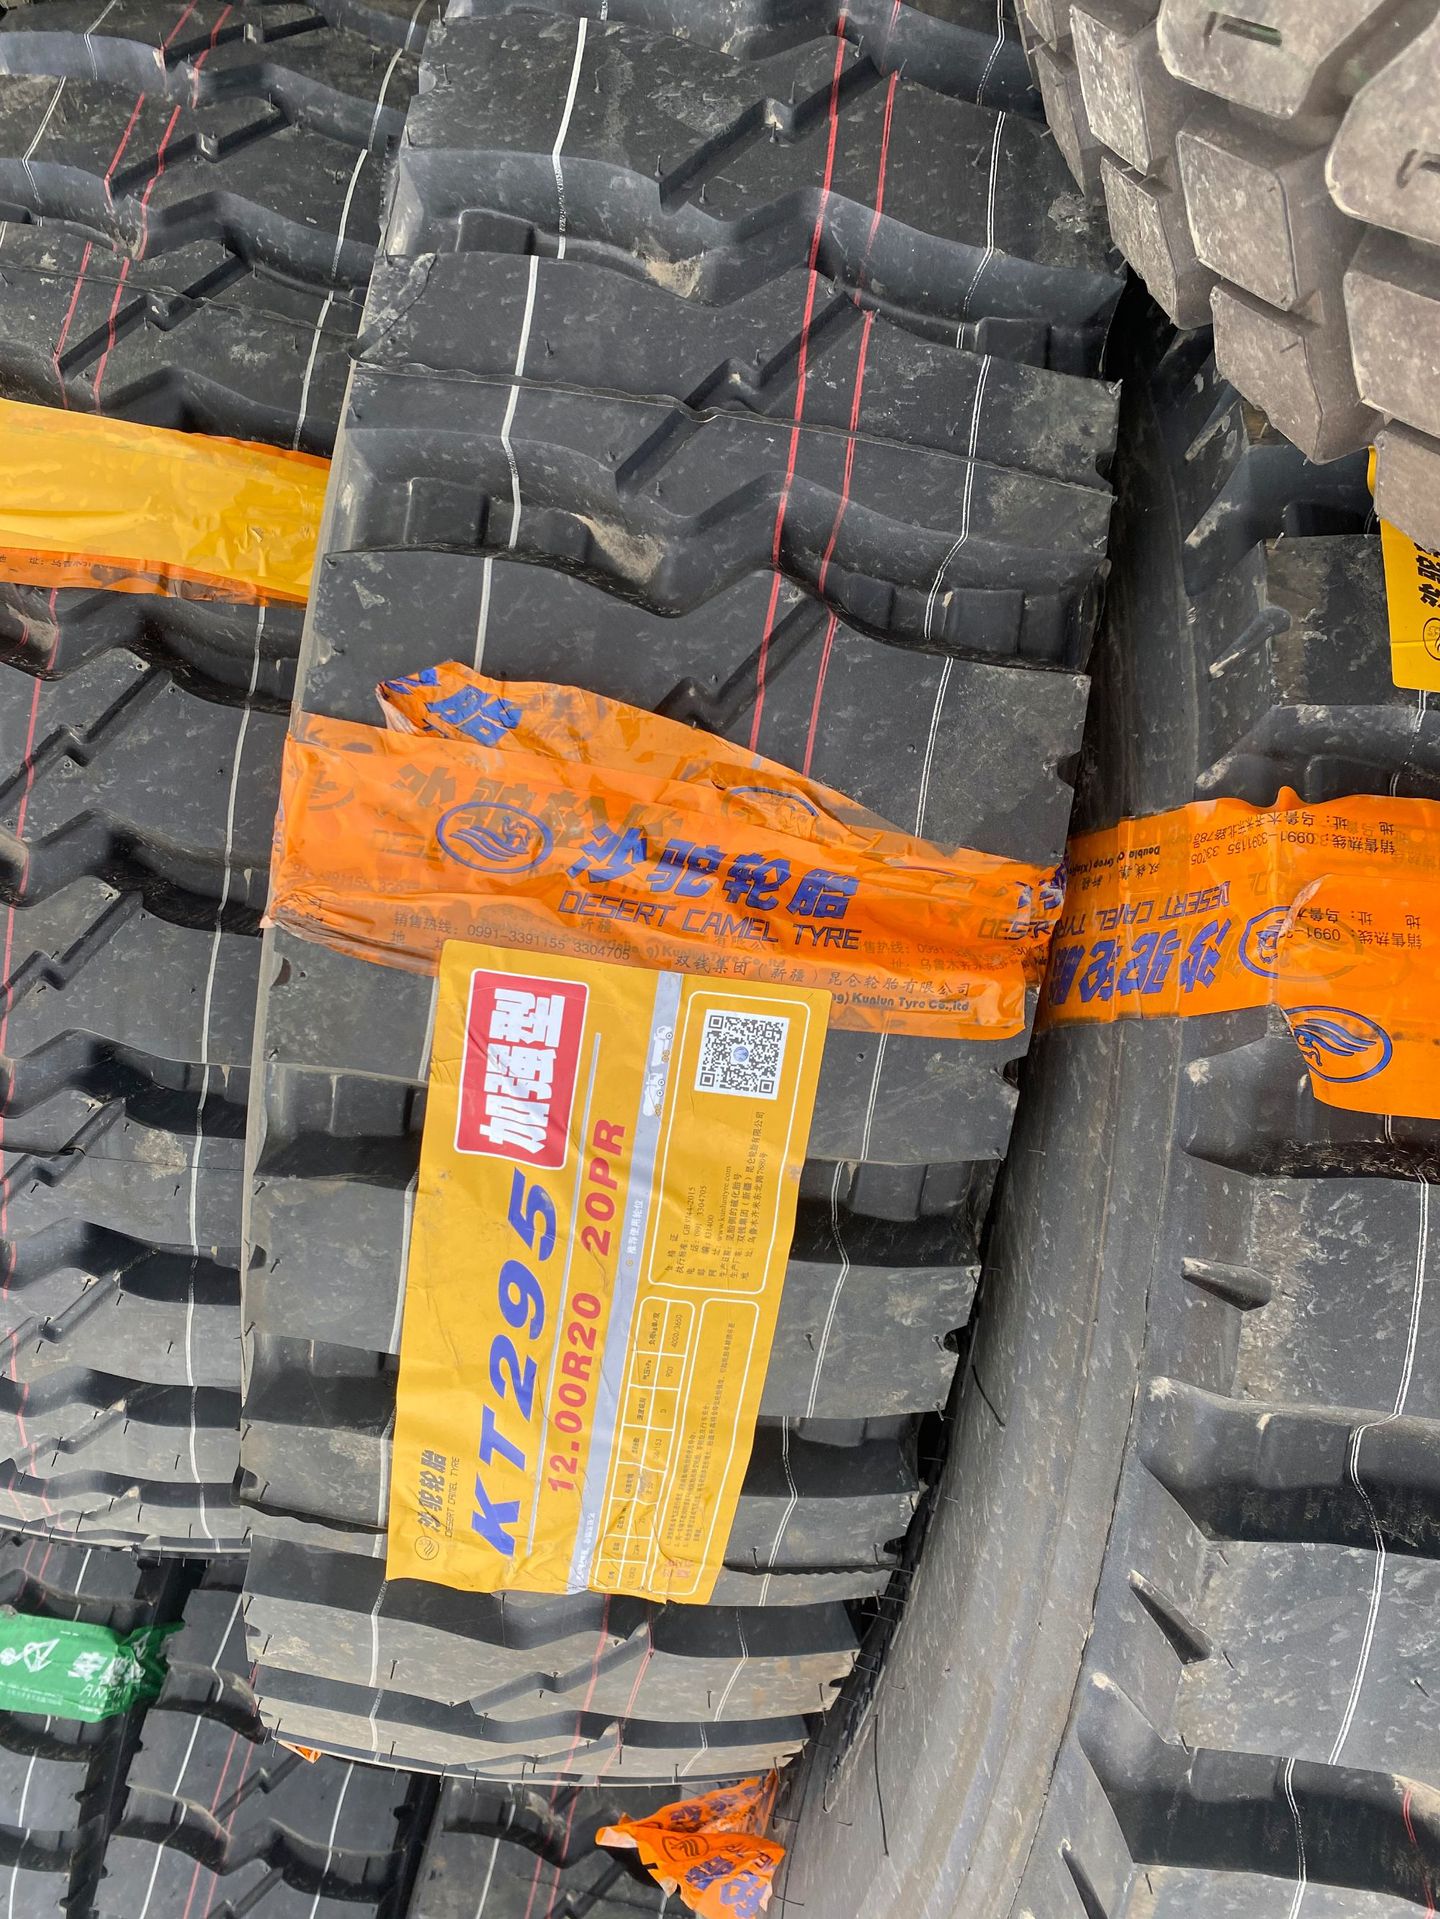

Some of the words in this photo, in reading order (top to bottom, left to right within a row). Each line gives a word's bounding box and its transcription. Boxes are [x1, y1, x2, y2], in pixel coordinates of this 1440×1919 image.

[566, 821, 860, 921] 沙驼轮胎
[467, 924, 566, 950] 0991-3391155
[573, 941, 630, 961] 3304705
[557, 890, 675, 930] DESERT
[681, 907, 780, 944] CAMEL
[791, 924, 862, 951] TYRE
[851, 990, 896, 1009] Kunlun
[479, 987, 566, 1155] 加强型
[698, 1184, 708, 1215] 3304705
[718, 1166, 733, 1242] www.kunluntyre.com
[548, 1292, 602, 1494] 12.00R20
[579, 1119, 627, 1256] 20PR
[470, 1166, 557, 1557] KT295
[417, 1449, 448, 1531] 沙驼轮胎
[443, 1506, 455, 1537] DESERT
[449, 1455, 460, 1476] TYRE
